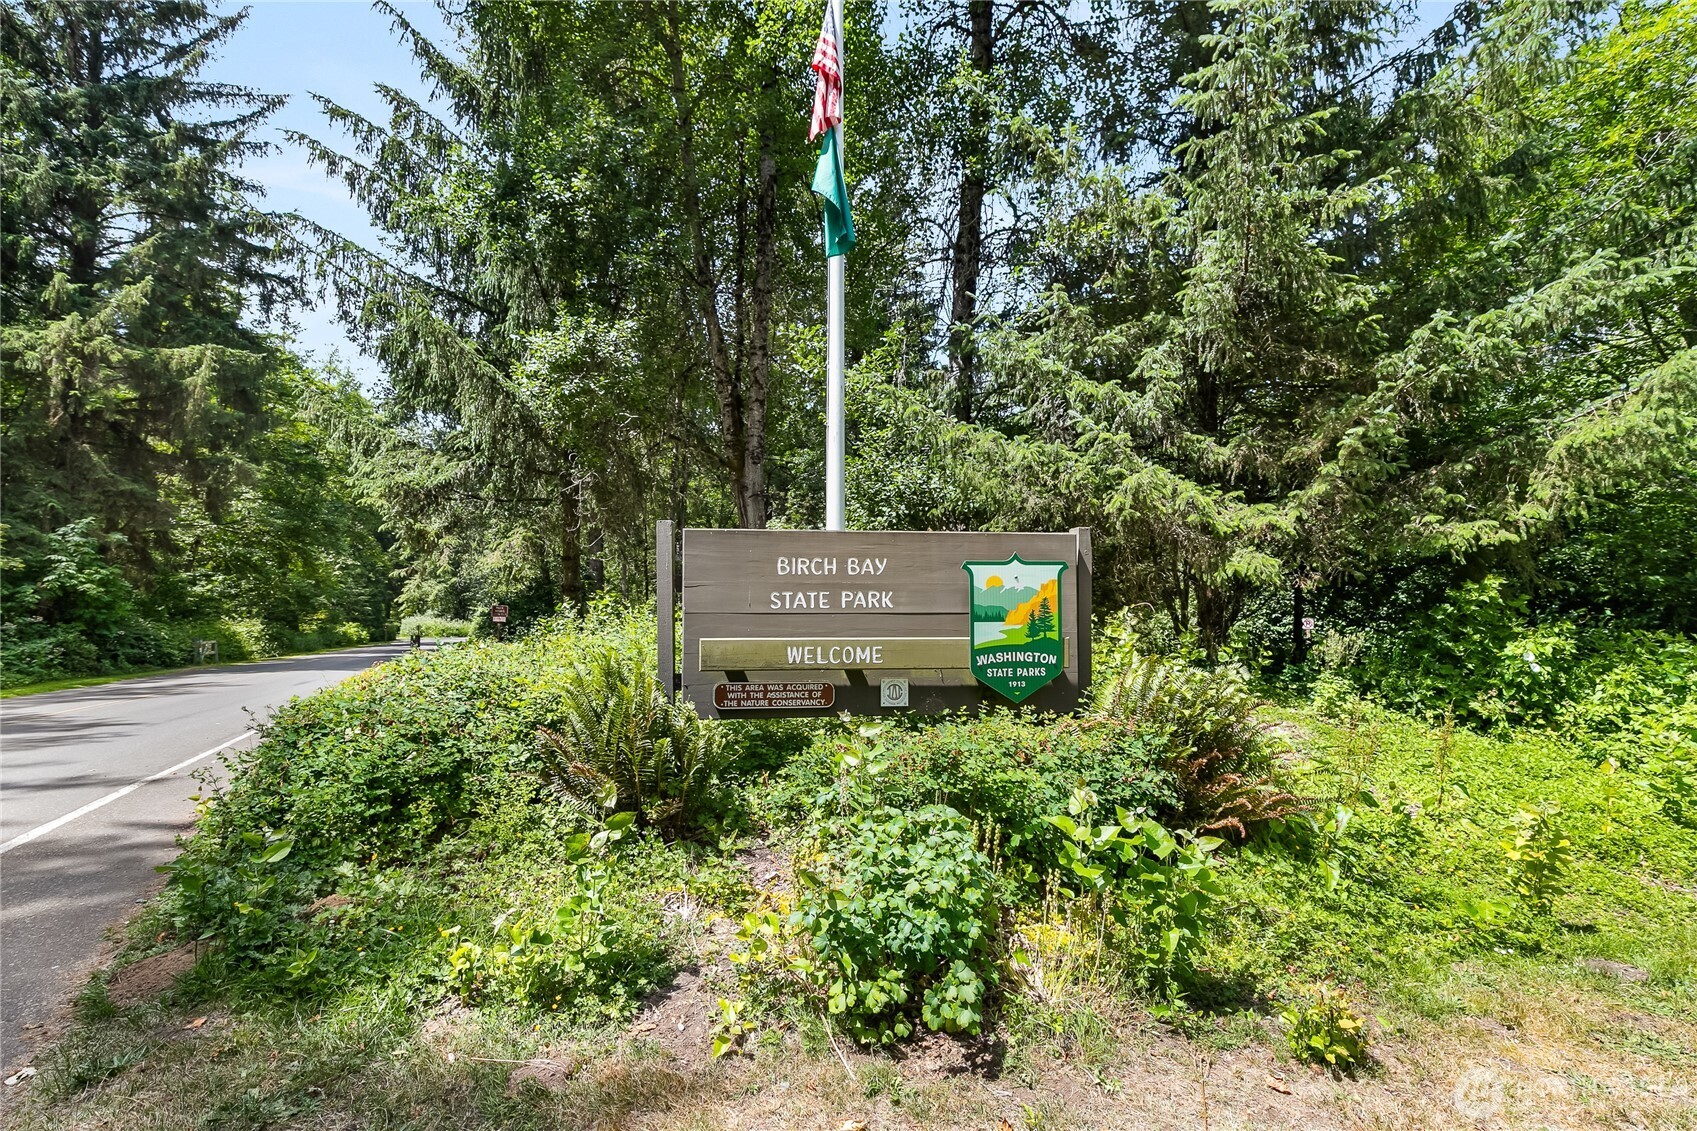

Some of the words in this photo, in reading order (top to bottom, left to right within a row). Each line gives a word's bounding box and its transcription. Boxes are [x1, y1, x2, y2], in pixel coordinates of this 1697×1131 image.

[776, 557, 837, 576] BIRCH
[846, 557, 888, 576] BAY
[770, 591, 830, 609] STATE
[841, 591, 894, 609] PARK
[786, 645, 884, 665] WELCOME
[976, 651, 1057, 666] WASHINGTON
[986, 667, 1014, 678] STATE
[1016, 667, 1046, 677] PARKS
[726, 684, 743, 692] THIS
[785, 683, 824, 691] ACQUIRED
[1008, 680, 1026, 688] 1913
[766, 691, 809, 699] ASSISTANCE
[740, 699, 769, 707] NATURE
